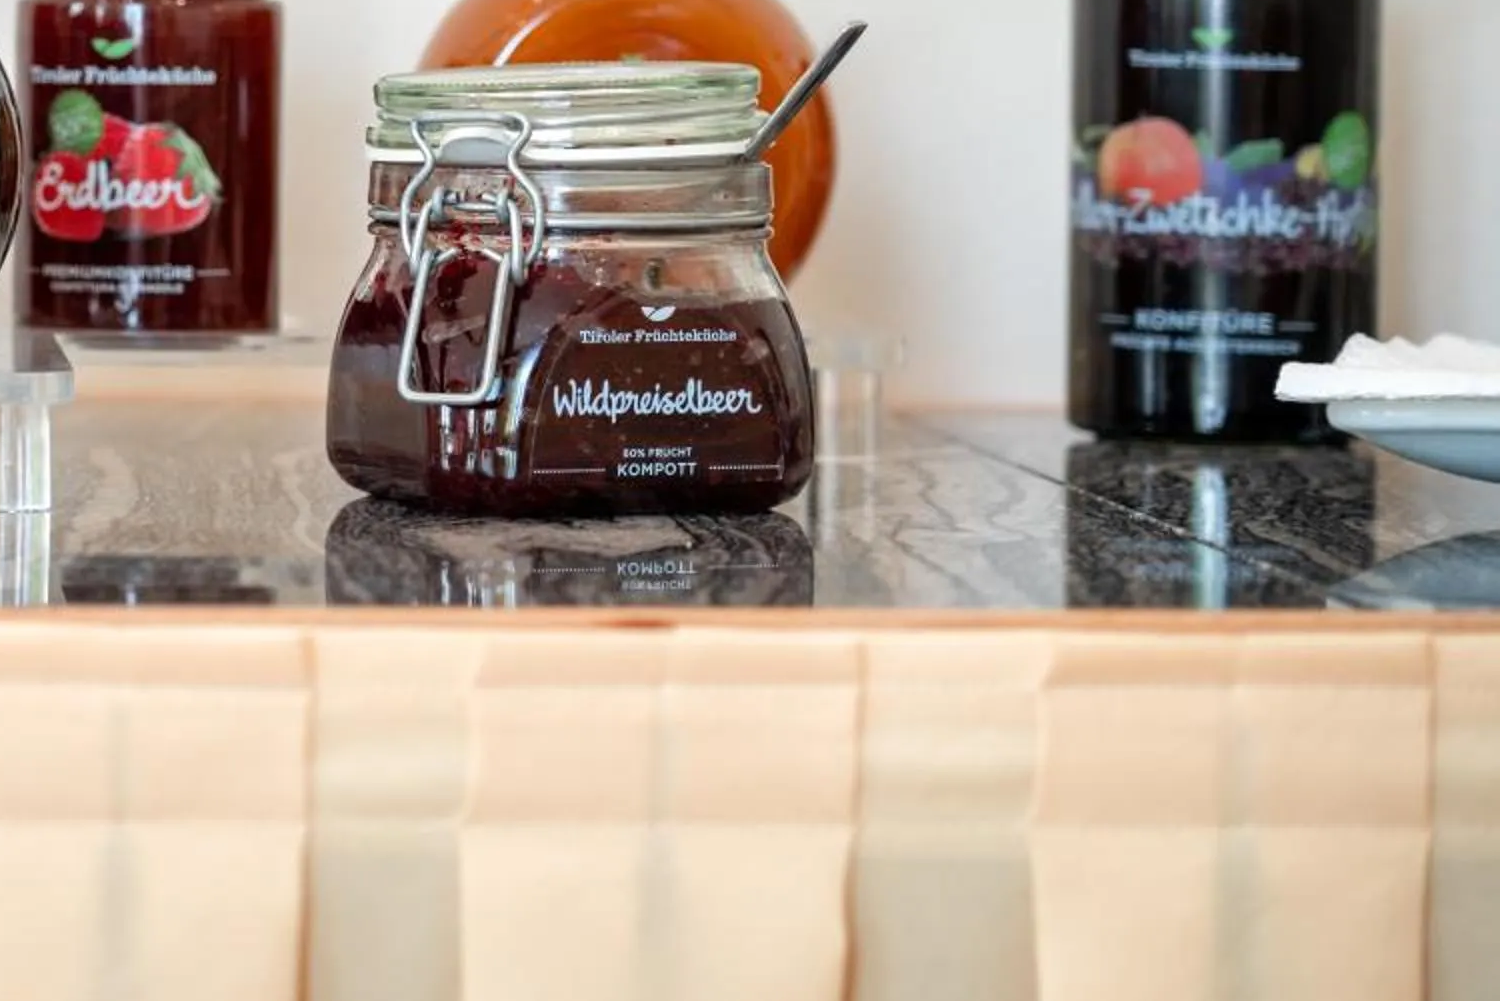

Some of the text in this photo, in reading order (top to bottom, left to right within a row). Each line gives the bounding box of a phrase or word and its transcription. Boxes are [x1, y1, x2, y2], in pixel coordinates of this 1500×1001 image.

[36, 159, 207, 212] Erdbeer
[580, 328, 737, 344] Tiroler Früchteküche
[553, 377, 763, 424] Wildpreiselbeer
[648, 446, 693, 458] FRUCHT
[617, 462, 698, 477] KOMPOTT
